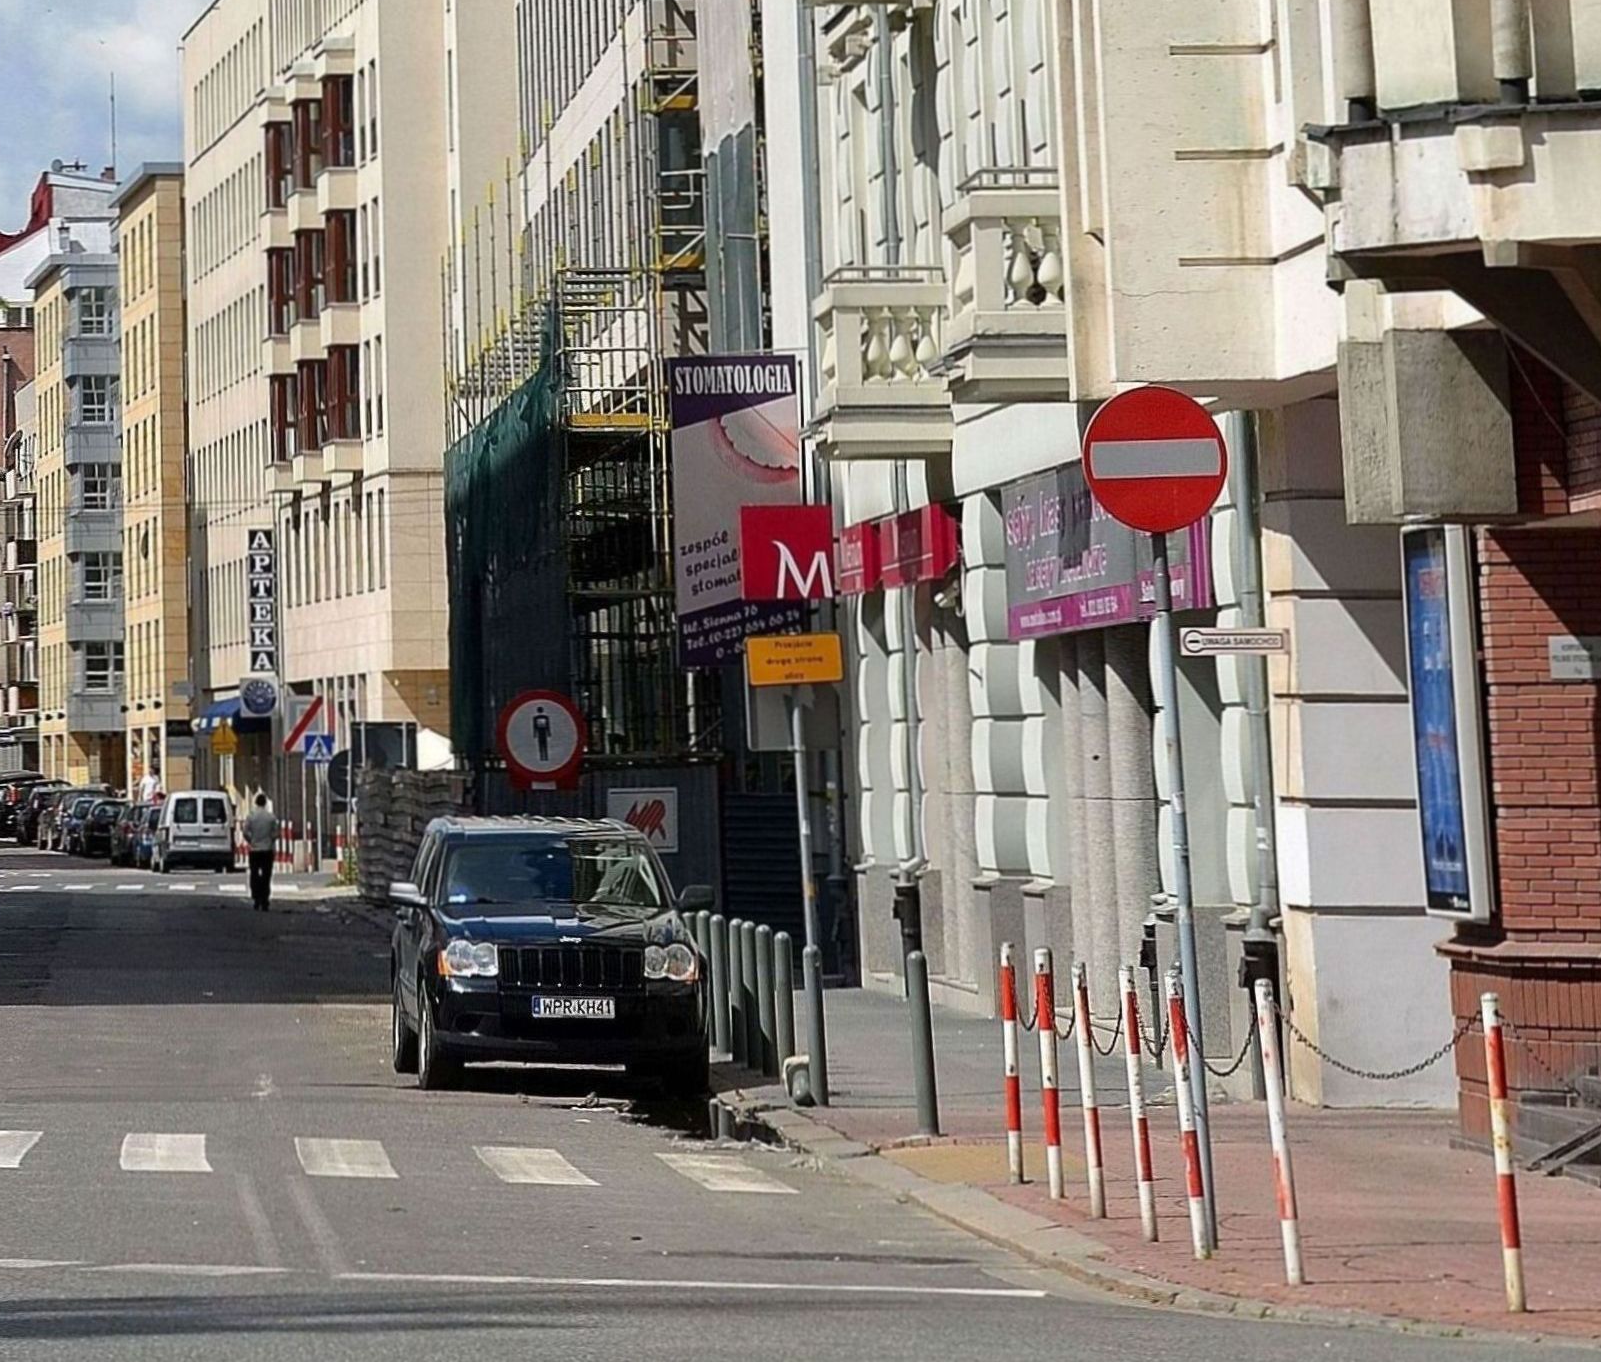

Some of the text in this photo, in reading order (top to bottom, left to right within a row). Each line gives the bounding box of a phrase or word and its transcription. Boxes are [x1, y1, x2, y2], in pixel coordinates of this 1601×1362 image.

[675, 364, 792, 395] STOMATOLOGIA
[772, 540, 834, 599] M
[251, 531, 273, 670] APTEKA
[703, 612, 742, 629] Sienna
